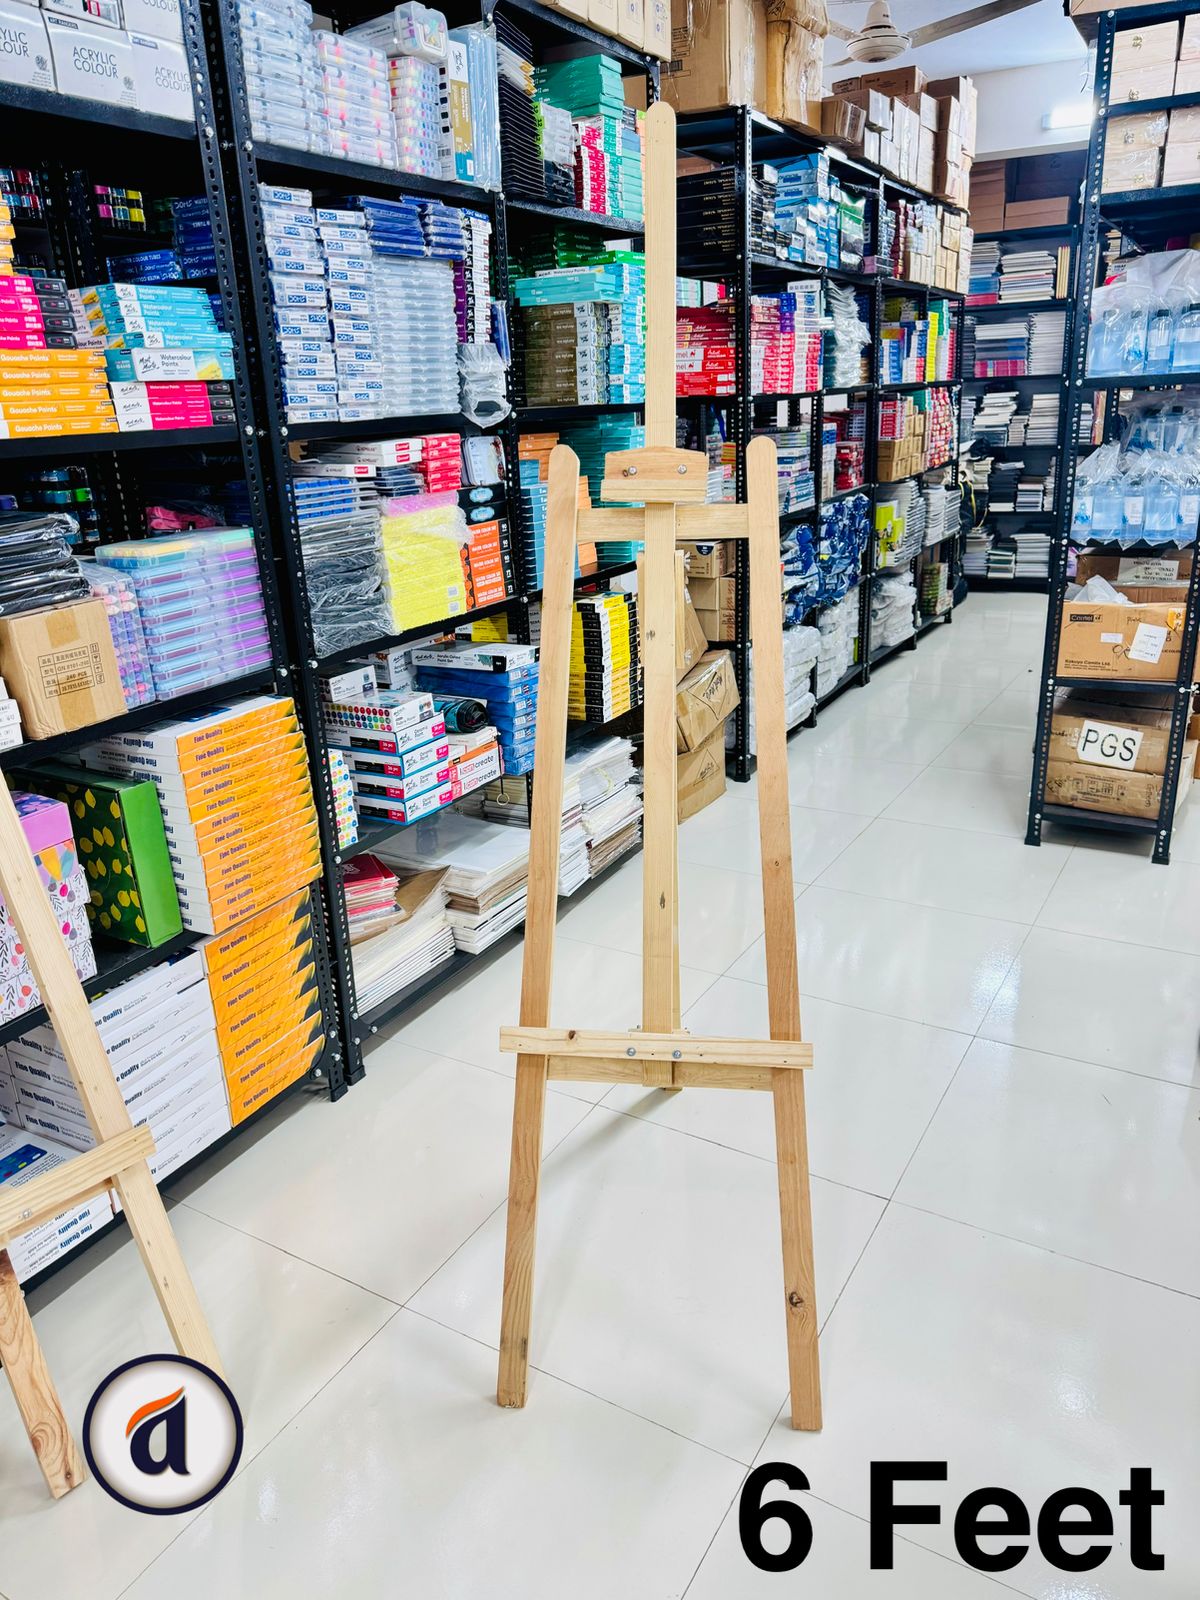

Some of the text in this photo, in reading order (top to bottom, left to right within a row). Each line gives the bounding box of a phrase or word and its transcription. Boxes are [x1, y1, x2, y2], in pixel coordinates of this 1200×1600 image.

[0, 29, 27, 45] YLIC
[0, 41, 29, 57] OUR
[73, 46, 117, 66] ACRYLIC
[74, 59, 118, 79] COLOUR
[155, 66, 190, 83] ACRYLIC
[160, 353, 191, 361] Watercolour
[676, 350, 688, 358] mel
[124, 737, 154, 749] Fine Quality
[194, 728, 223, 743] Fine Quality
[195, 745, 225, 761] Fine Quality
[1081, 728, 1136, 761] PGS
[128, 755, 157, 767] Fine Quality
[475, 755, 494, 768] create
[133, 771, 162, 783] Fine Quality
[201, 762, 230, 778] Fine Quality
[479, 769, 497, 781] create
[203, 779, 233, 796] Fine Quality
[206, 795, 235, 811] Fine Quality
[212, 811, 240, 828] Fine Quality
[214, 827, 243, 844] Fine Quality
[219, 842, 247, 860] Fine Quality
[221, 858, 250, 876] Fine Quality
[224, 873, 252, 890] Fine Quality
[227, 887, 254, 906] Fine Quality
[229, 903, 256, 921] Fine Quality
[219, 934, 248, 954] Fine Quality
[222, 961, 250, 982] Fine Quality
[227, 987, 255, 1008] Fine Quality
[103, 1008, 122, 1022] Quality
[230, 1012, 256, 1033] Fine Quality
[20, 1037, 42, 1052] Quality
[111, 1037, 131, 1052] Quality
[235, 1036, 261, 1058] Fine Quality
[15, 1061, 51, 1080] Fine Quality
[121, 1063, 139, 1079] Quality
[240, 1062, 266, 1083] Fine Quality
[20, 1088, 55, 1106] Fine Quality
[124, 1091, 143, 1106] Quality
[243, 1086, 269, 1108] Fine Quality
[25, 1115, 60, 1133] Fine Quality
[58, 1208, 91, 1235] Fine Quality
[60, 1223, 93, 1249] Fine Quality
